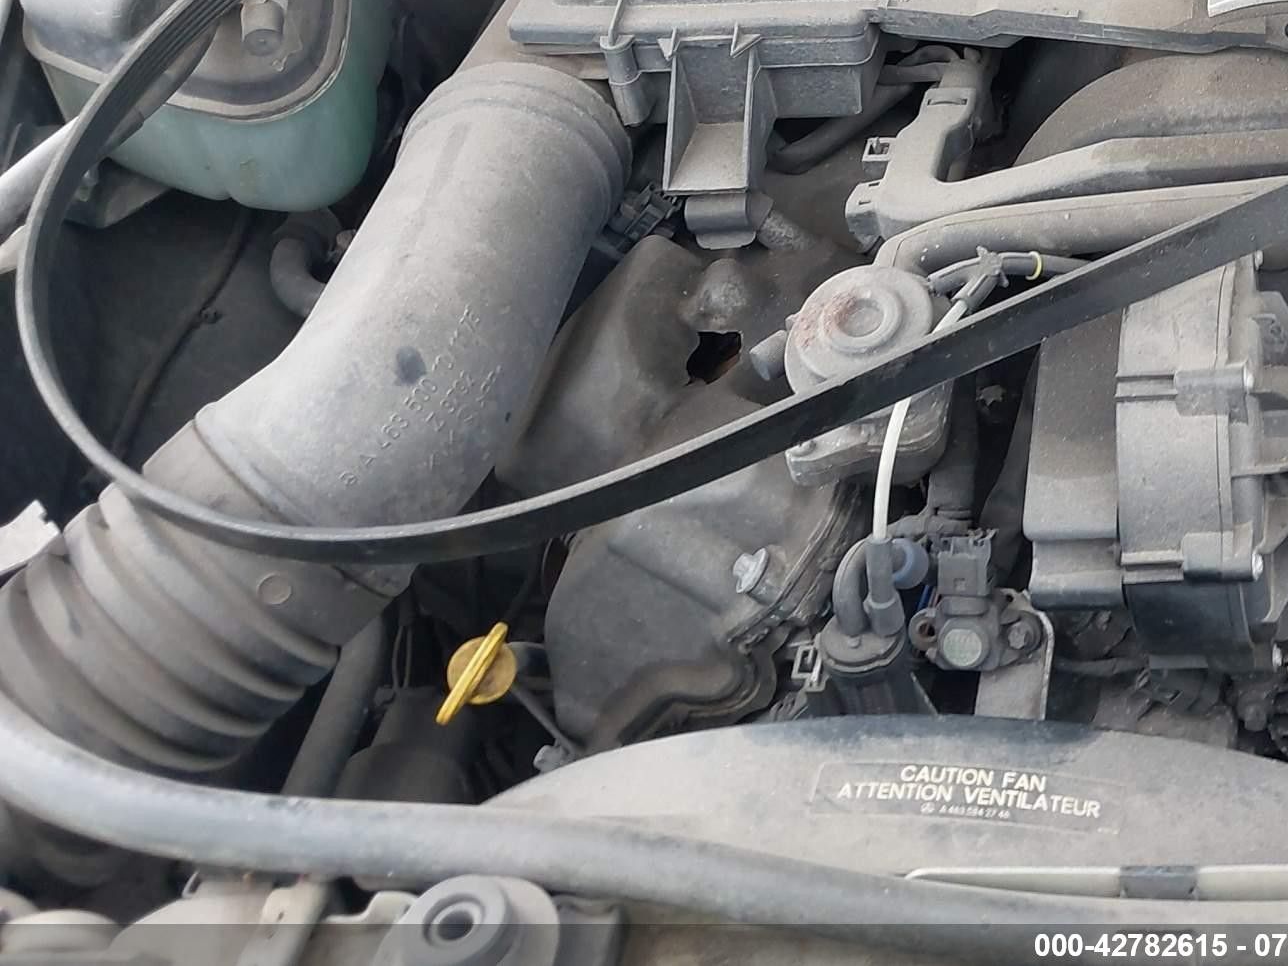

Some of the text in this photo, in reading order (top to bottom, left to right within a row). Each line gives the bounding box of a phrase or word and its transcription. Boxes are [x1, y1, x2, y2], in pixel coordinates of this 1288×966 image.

[403, 376, 438, 412] 500
[901, 765, 1047, 793] CAUTION FAN
[837, 782, 1101, 819] ATTENTION VENTILATEUR
